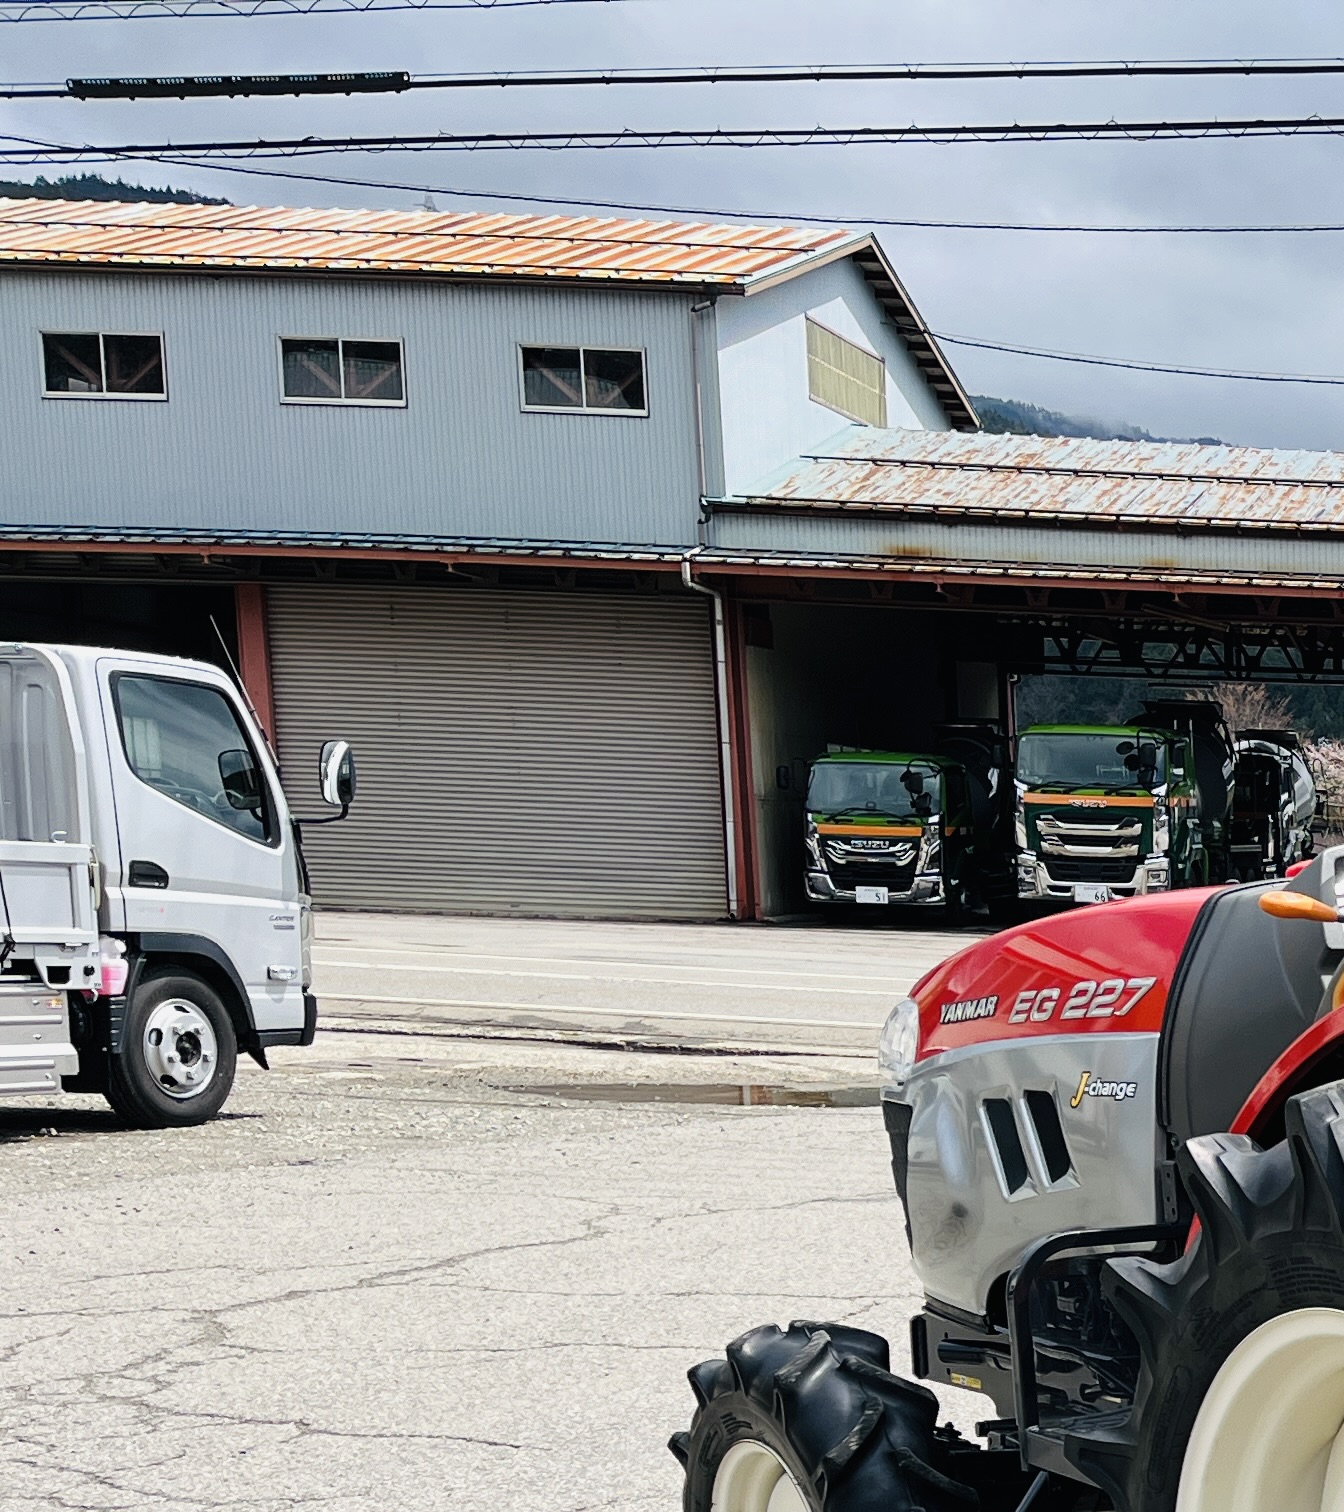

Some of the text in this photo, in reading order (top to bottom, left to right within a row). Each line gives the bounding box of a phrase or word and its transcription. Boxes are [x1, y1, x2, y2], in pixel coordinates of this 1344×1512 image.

[851, 840, 889, 849] ISUZU
[940, 996, 998, 1024] YANMAR
[1061, 977, 1157, 1020] 227
